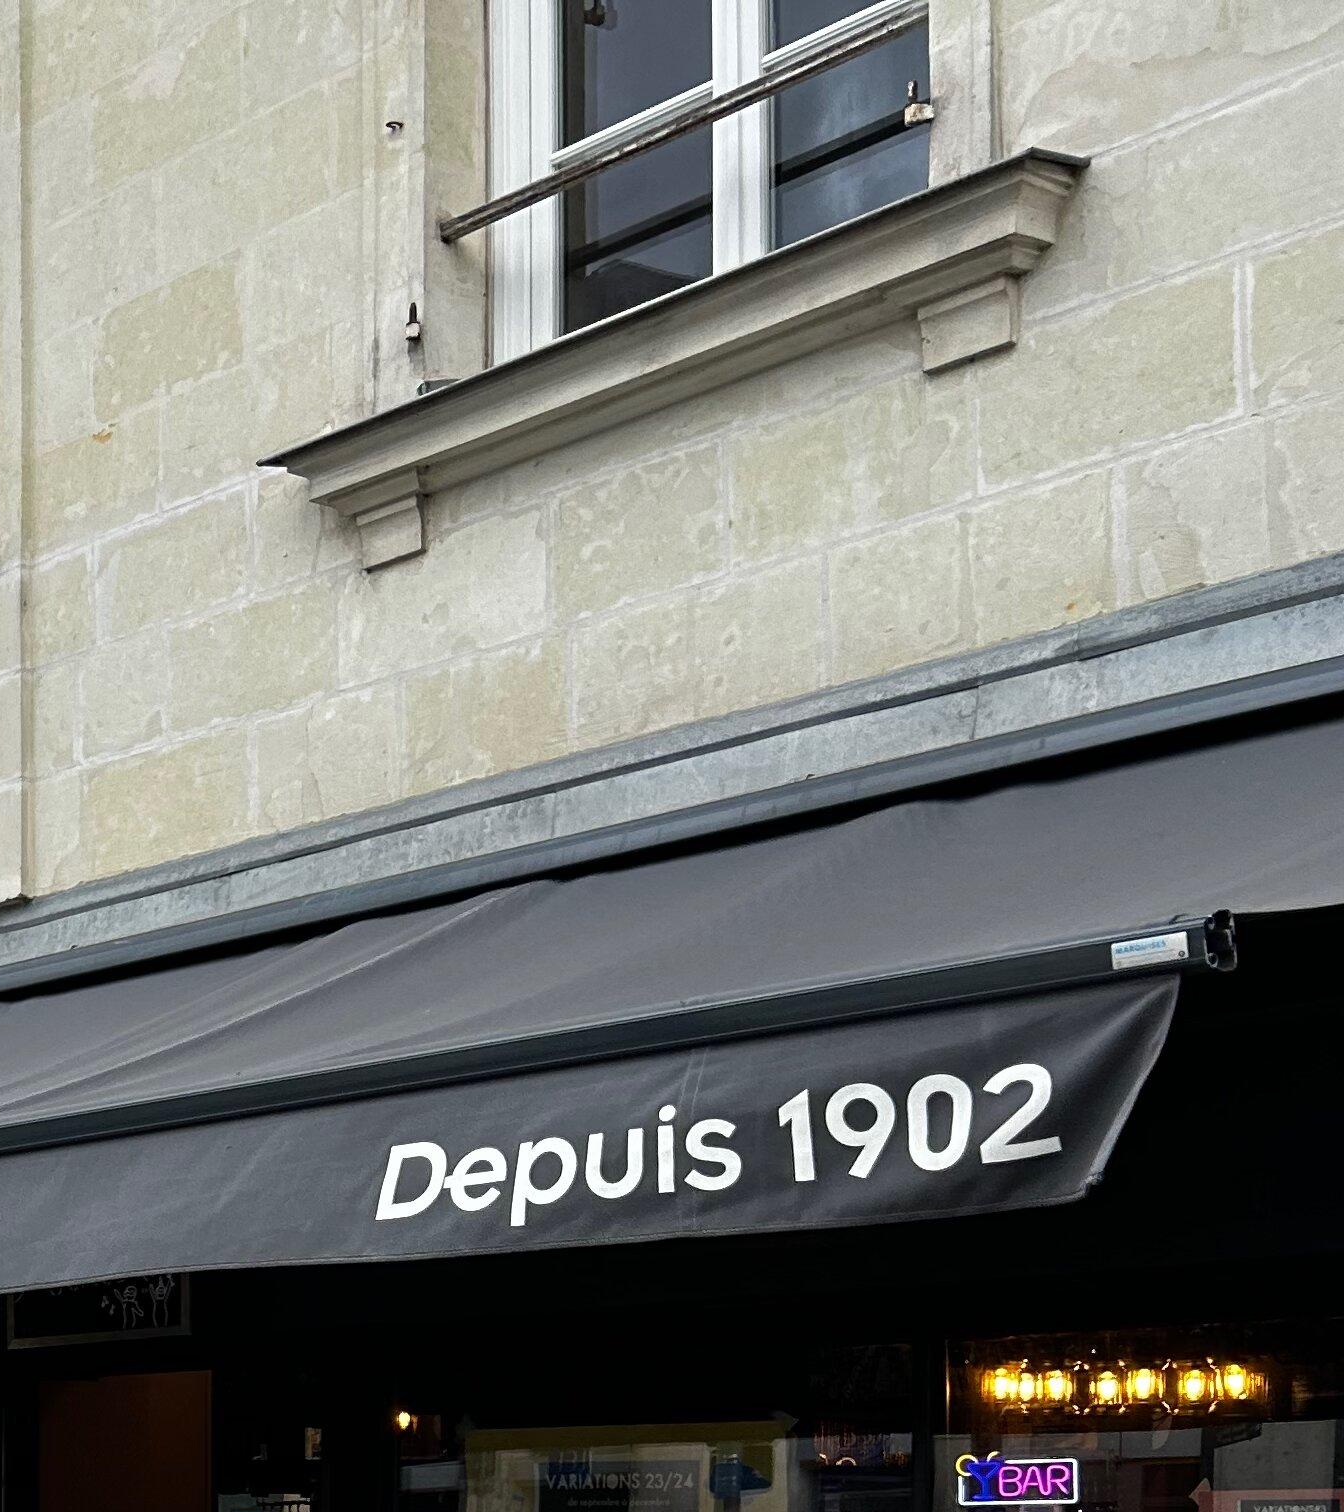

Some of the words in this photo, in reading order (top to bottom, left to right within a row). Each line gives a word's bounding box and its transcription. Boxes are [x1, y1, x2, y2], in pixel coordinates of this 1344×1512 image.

[373, 1103, 743, 1227] Depuis
[778, 1062, 1063, 1183] 1902
[546, 1472, 641, 1491] VARIATIONS
[643, 1472, 694, 1493] 23/24
[998, 1464, 1072, 1498] BAR
